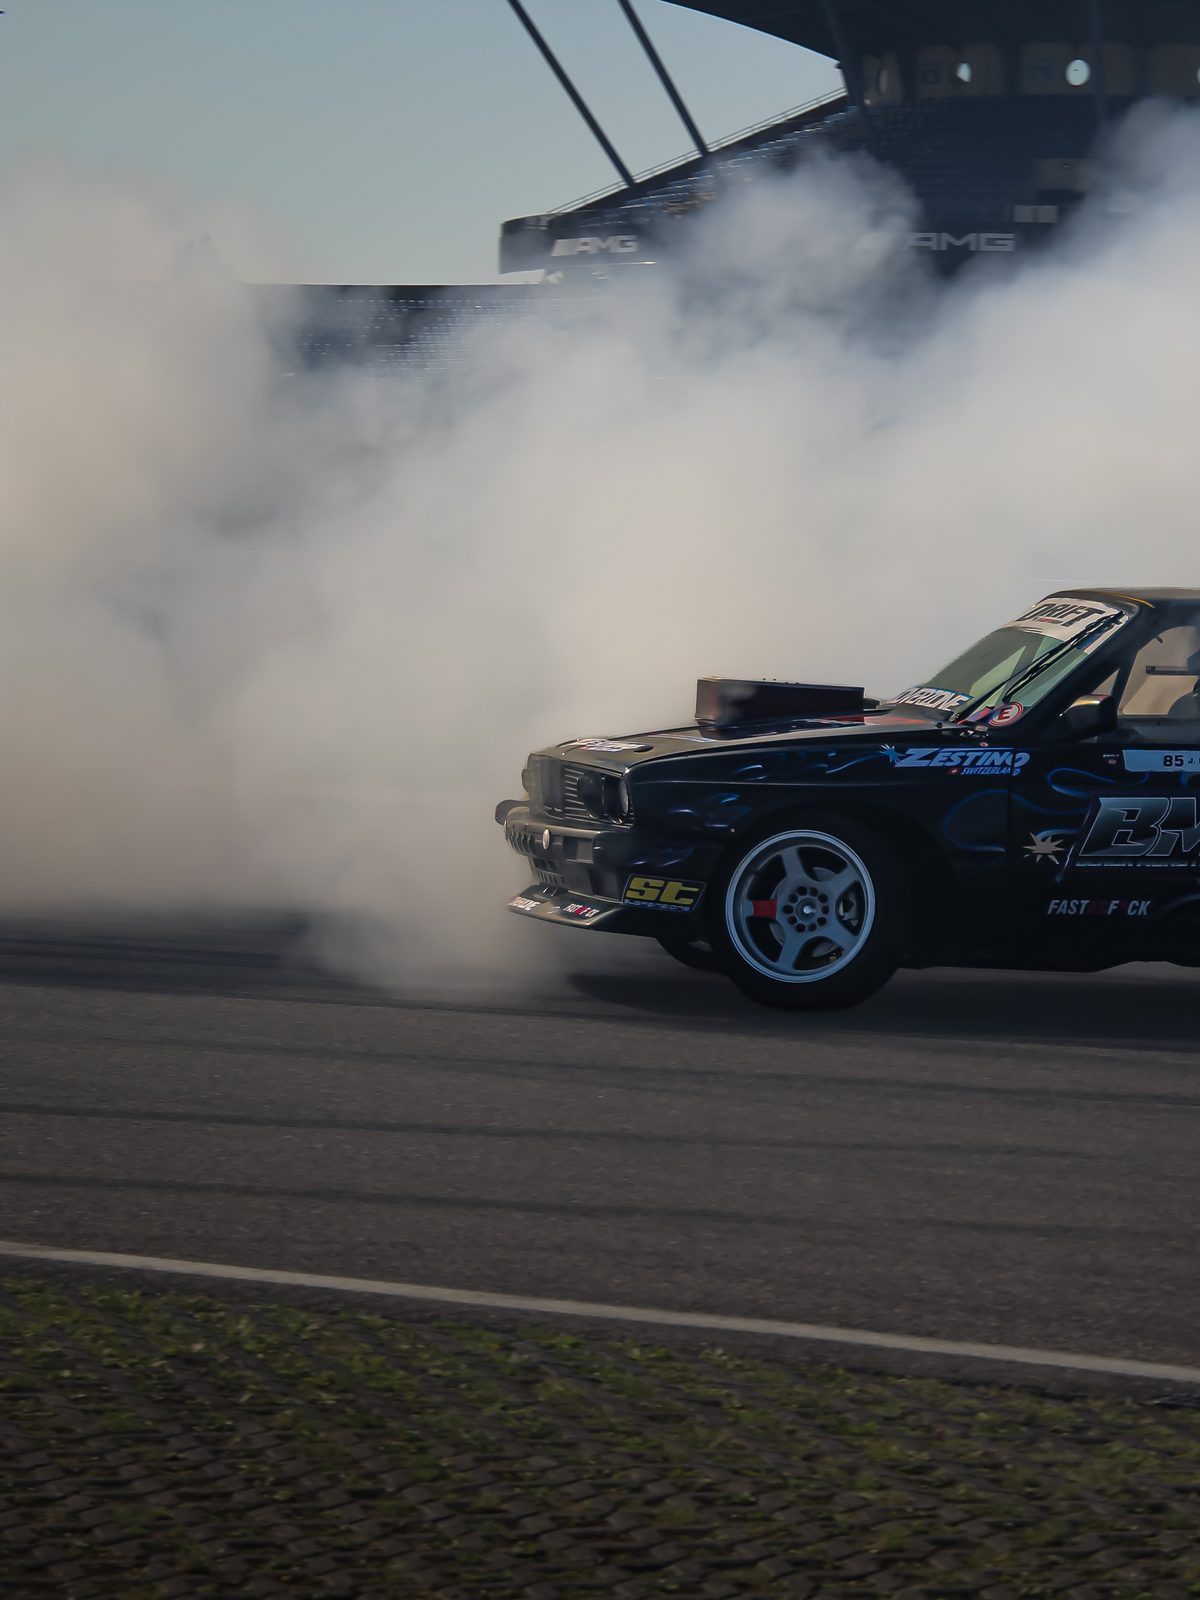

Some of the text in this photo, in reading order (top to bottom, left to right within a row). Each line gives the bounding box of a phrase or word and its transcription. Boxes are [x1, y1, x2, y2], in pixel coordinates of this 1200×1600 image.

[574, 234, 637, 254] AMG
[902, 232, 1015, 251] AMG
[1014, 603, 1106, 627] DRIFT
[896, 747, 1031, 768] ZESTINO
[1163, 755, 1184, 767] 85
[960, 766, 1021, 777] SWITZERLAND
[1047, 899, 1090, 915] FAST
